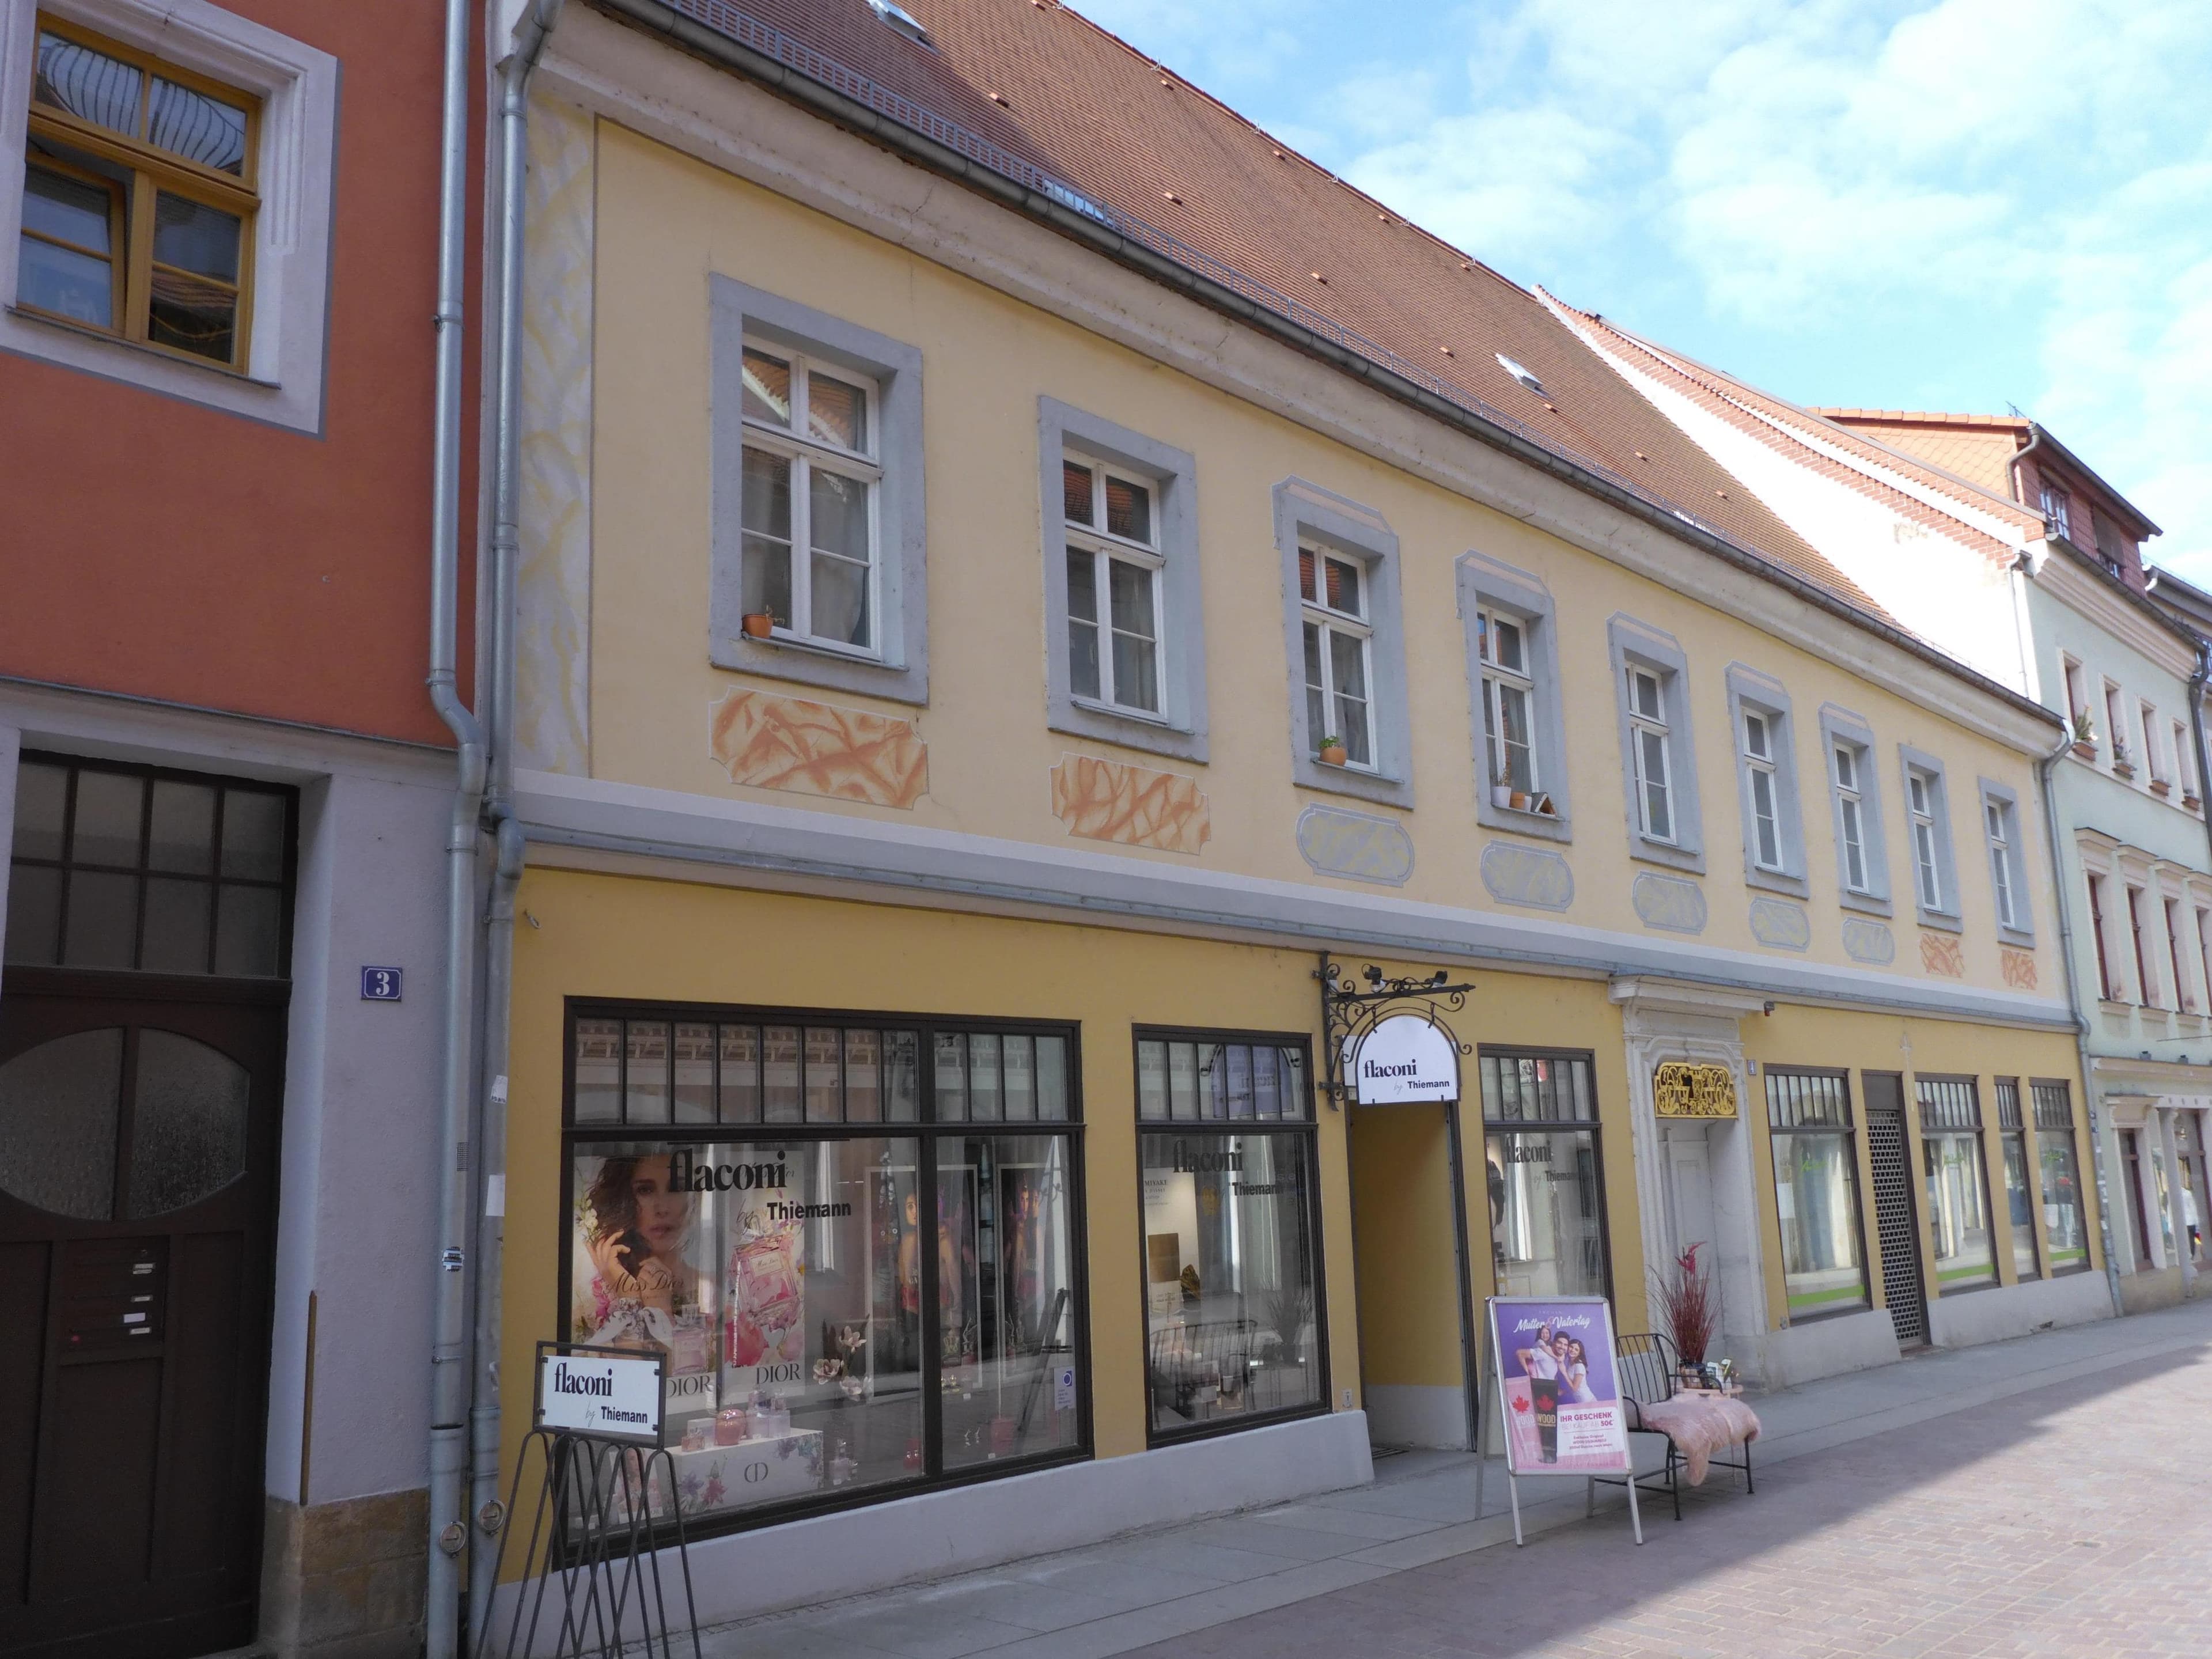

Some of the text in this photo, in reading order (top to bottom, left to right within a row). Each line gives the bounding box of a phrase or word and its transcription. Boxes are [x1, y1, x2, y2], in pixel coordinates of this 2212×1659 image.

[376, 972, 390, 995] 3
[1363, 1059, 1417, 1078] flaconi
[1393, 1080, 1450, 1095] by Thiemann
[1173, 1138, 1244, 1173] flaconi
[1506, 1133, 1552, 1163] flaconi
[666, 1148, 787, 1192] flaconi
[1232, 1181, 1284, 1196] Thiemann
[767, 1201, 851, 1220] Thiemann
[603, 1272, 647, 1294] Miss
[1513, 1319, 1546, 1333] Mutter
[1552, 1315, 1590, 1329] Vatertag
[555, 1362, 612, 1396] flaconi
[756, 1363, 801, 1384] DIOR
[585, 1400, 647, 1427] by Thiemann
[1574, 1411, 1612, 1421] GESCHENK
